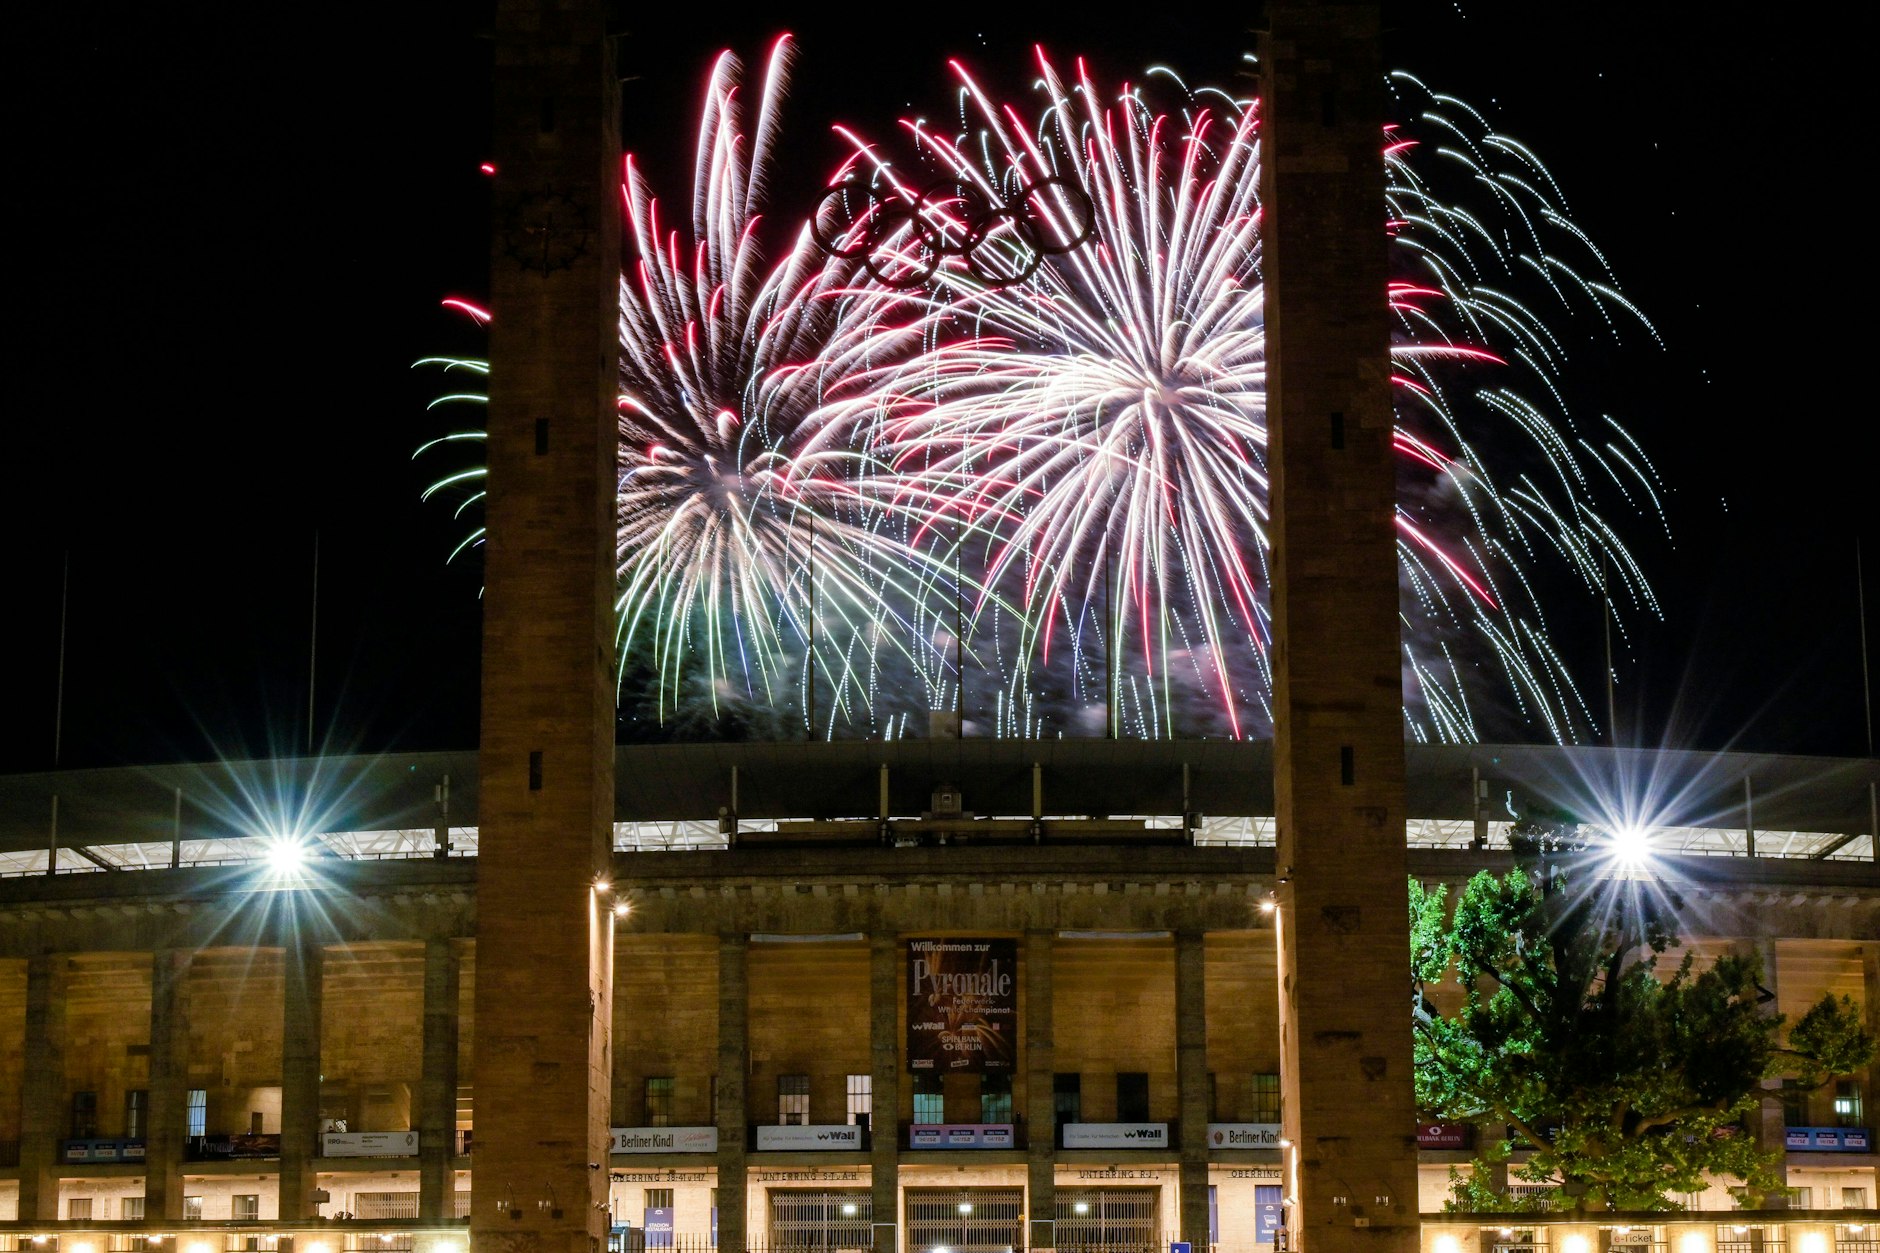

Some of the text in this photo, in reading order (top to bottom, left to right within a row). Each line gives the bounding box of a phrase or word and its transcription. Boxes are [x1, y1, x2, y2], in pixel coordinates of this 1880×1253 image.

[911, 942, 972, 951] Willkommen
[912, 959, 1011, 1006] Pyronale
[923, 1022, 945, 1030] Wall
[830, 1131, 855, 1140] Wall
[1136, 1129, 1161, 1138] Wall
[1229, 1130, 1260, 1143] Berliner
[621, 1135, 651, 1147] Berliner
[653, 1134, 674, 1147] Kindl
[762, 1172, 817, 1180] UNTERRING
[1079, 1170, 1134, 1178] UNTERRING
[1231, 1170, 1279, 1178] OBERRING
[1614, 1234, 1653, 1243] e-Ticket
